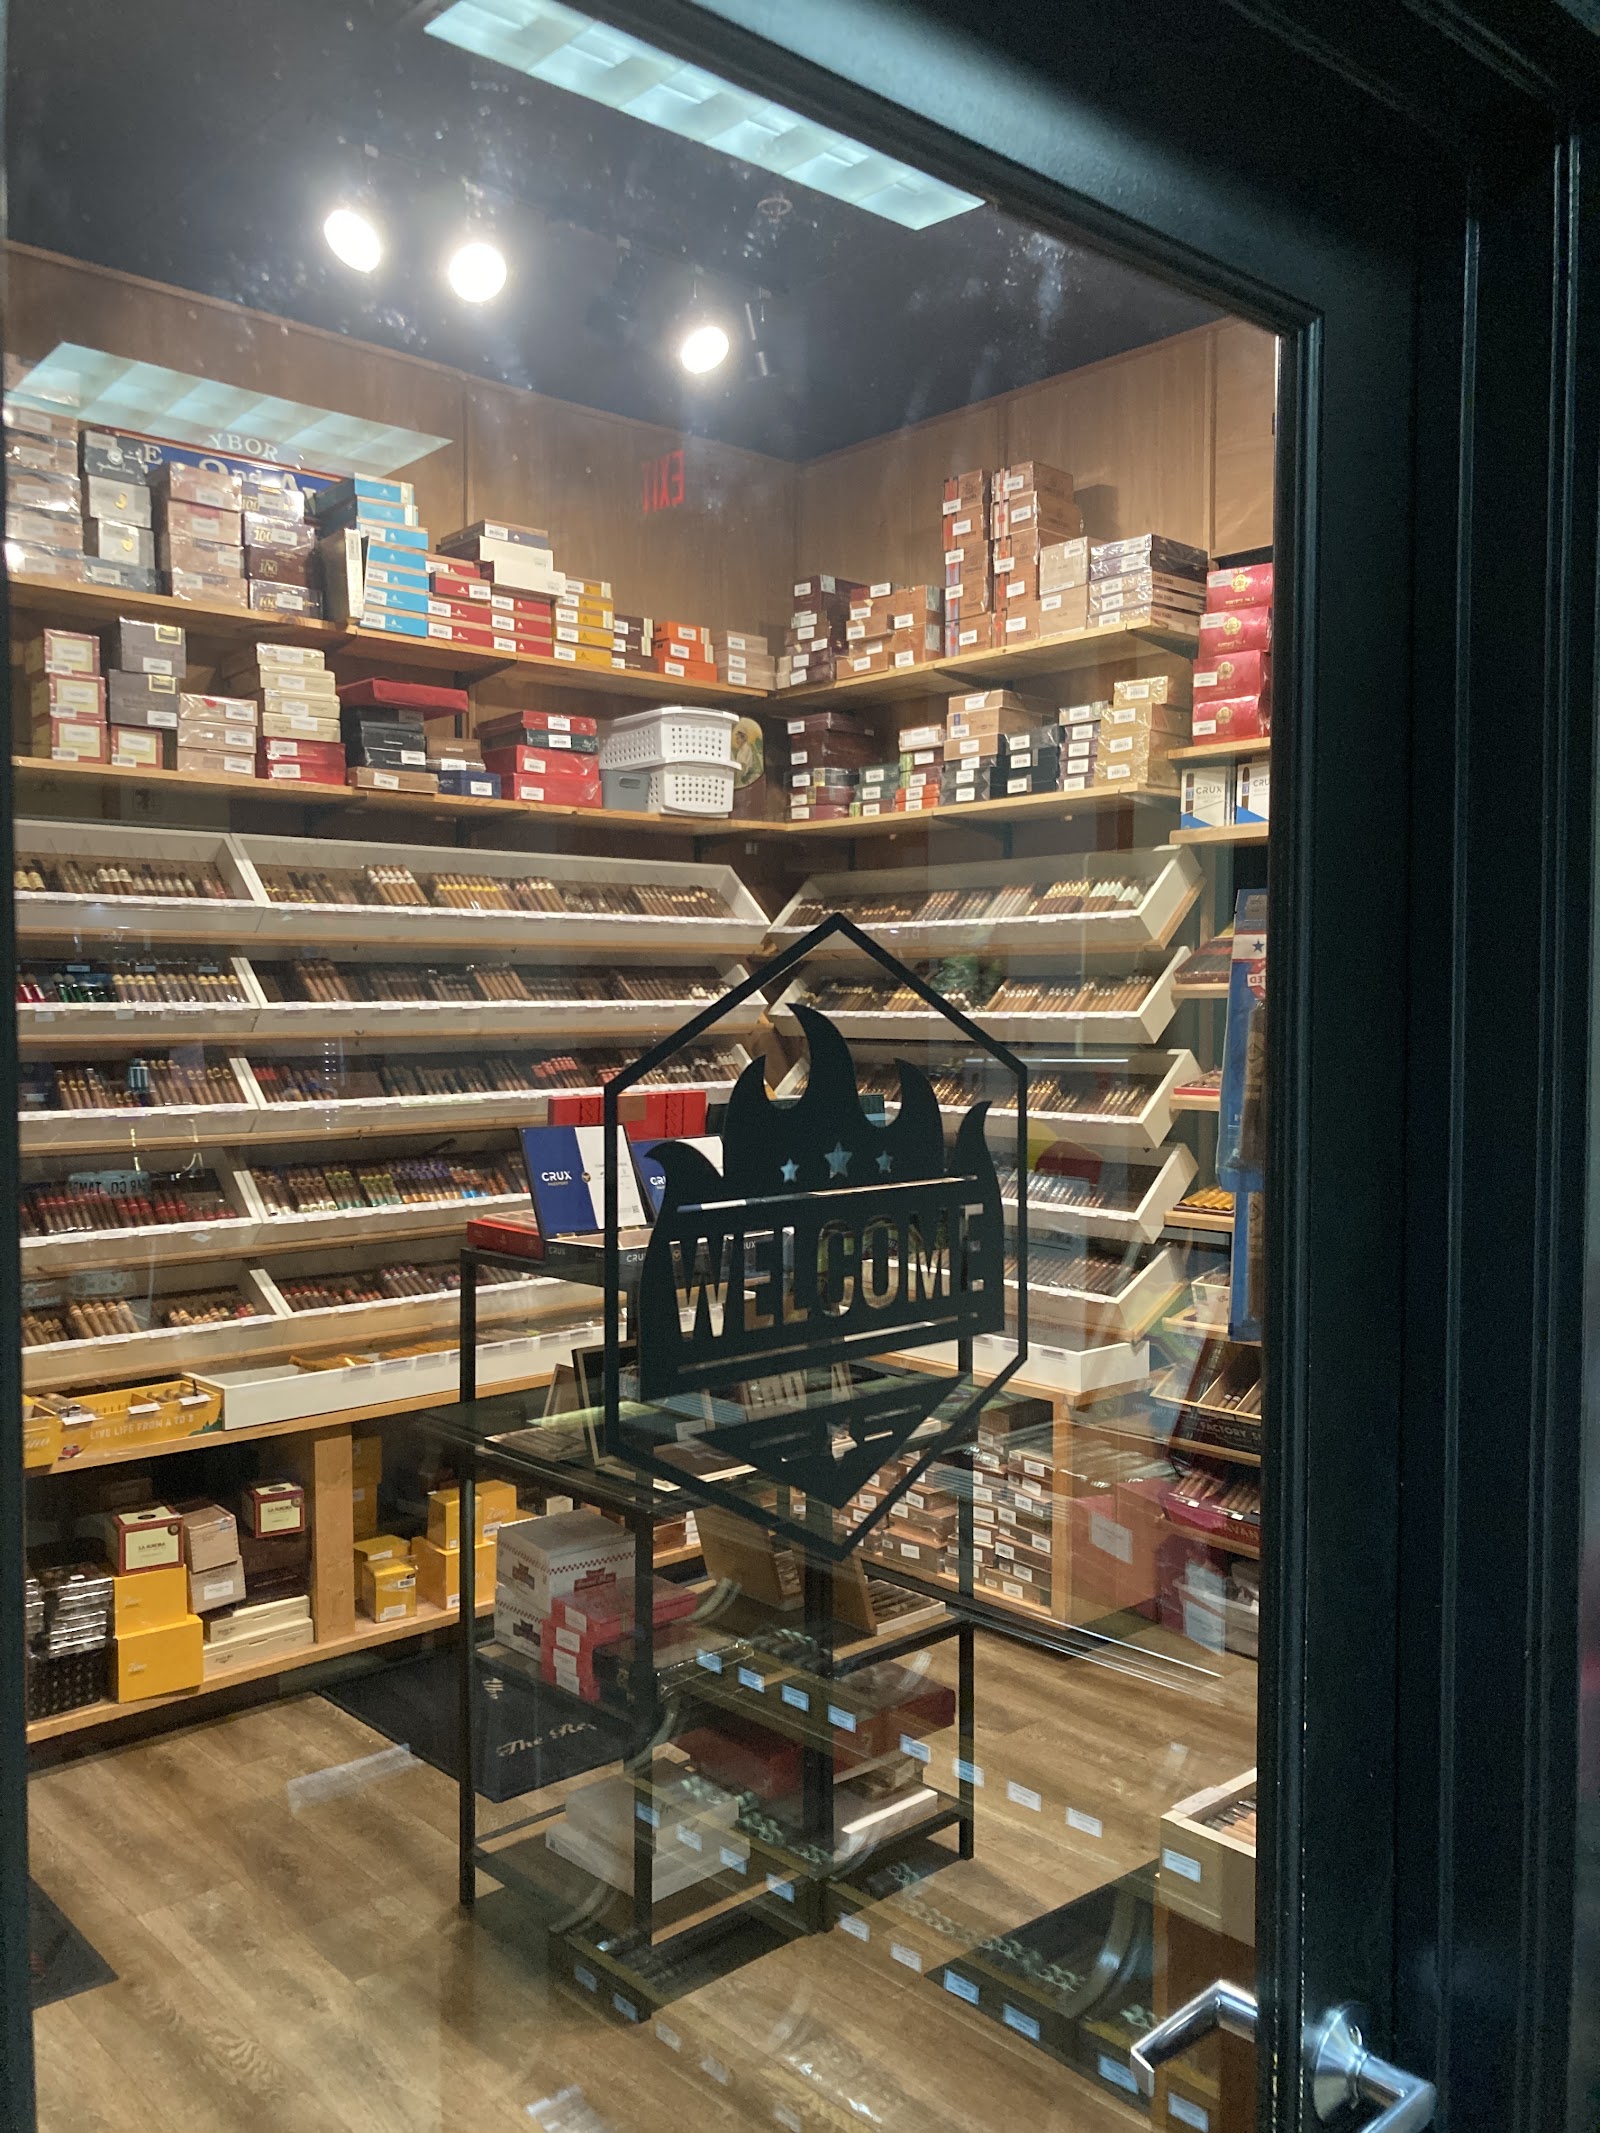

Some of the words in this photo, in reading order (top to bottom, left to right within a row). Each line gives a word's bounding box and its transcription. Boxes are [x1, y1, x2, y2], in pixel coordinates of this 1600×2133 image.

[208, 433, 279, 462] YBOR
[1195, 785, 1223, 795] CRUX
[1253, 778, 1270, 787] CRU
[541, 1170, 573, 1182] CRUX
[626, 1252, 645, 1263] CRU
[669, 1202, 985, 1340] WELCOME
[90, 1428, 111, 1440] LIVE
[114, 1425, 135, 1437] LIFE
[137, 1419, 164, 1432] FROM
[165, 1417, 172, 1428] A
[174, 1415, 186, 1426] TO
[1200, 1420, 1247, 1438] FACTORY
